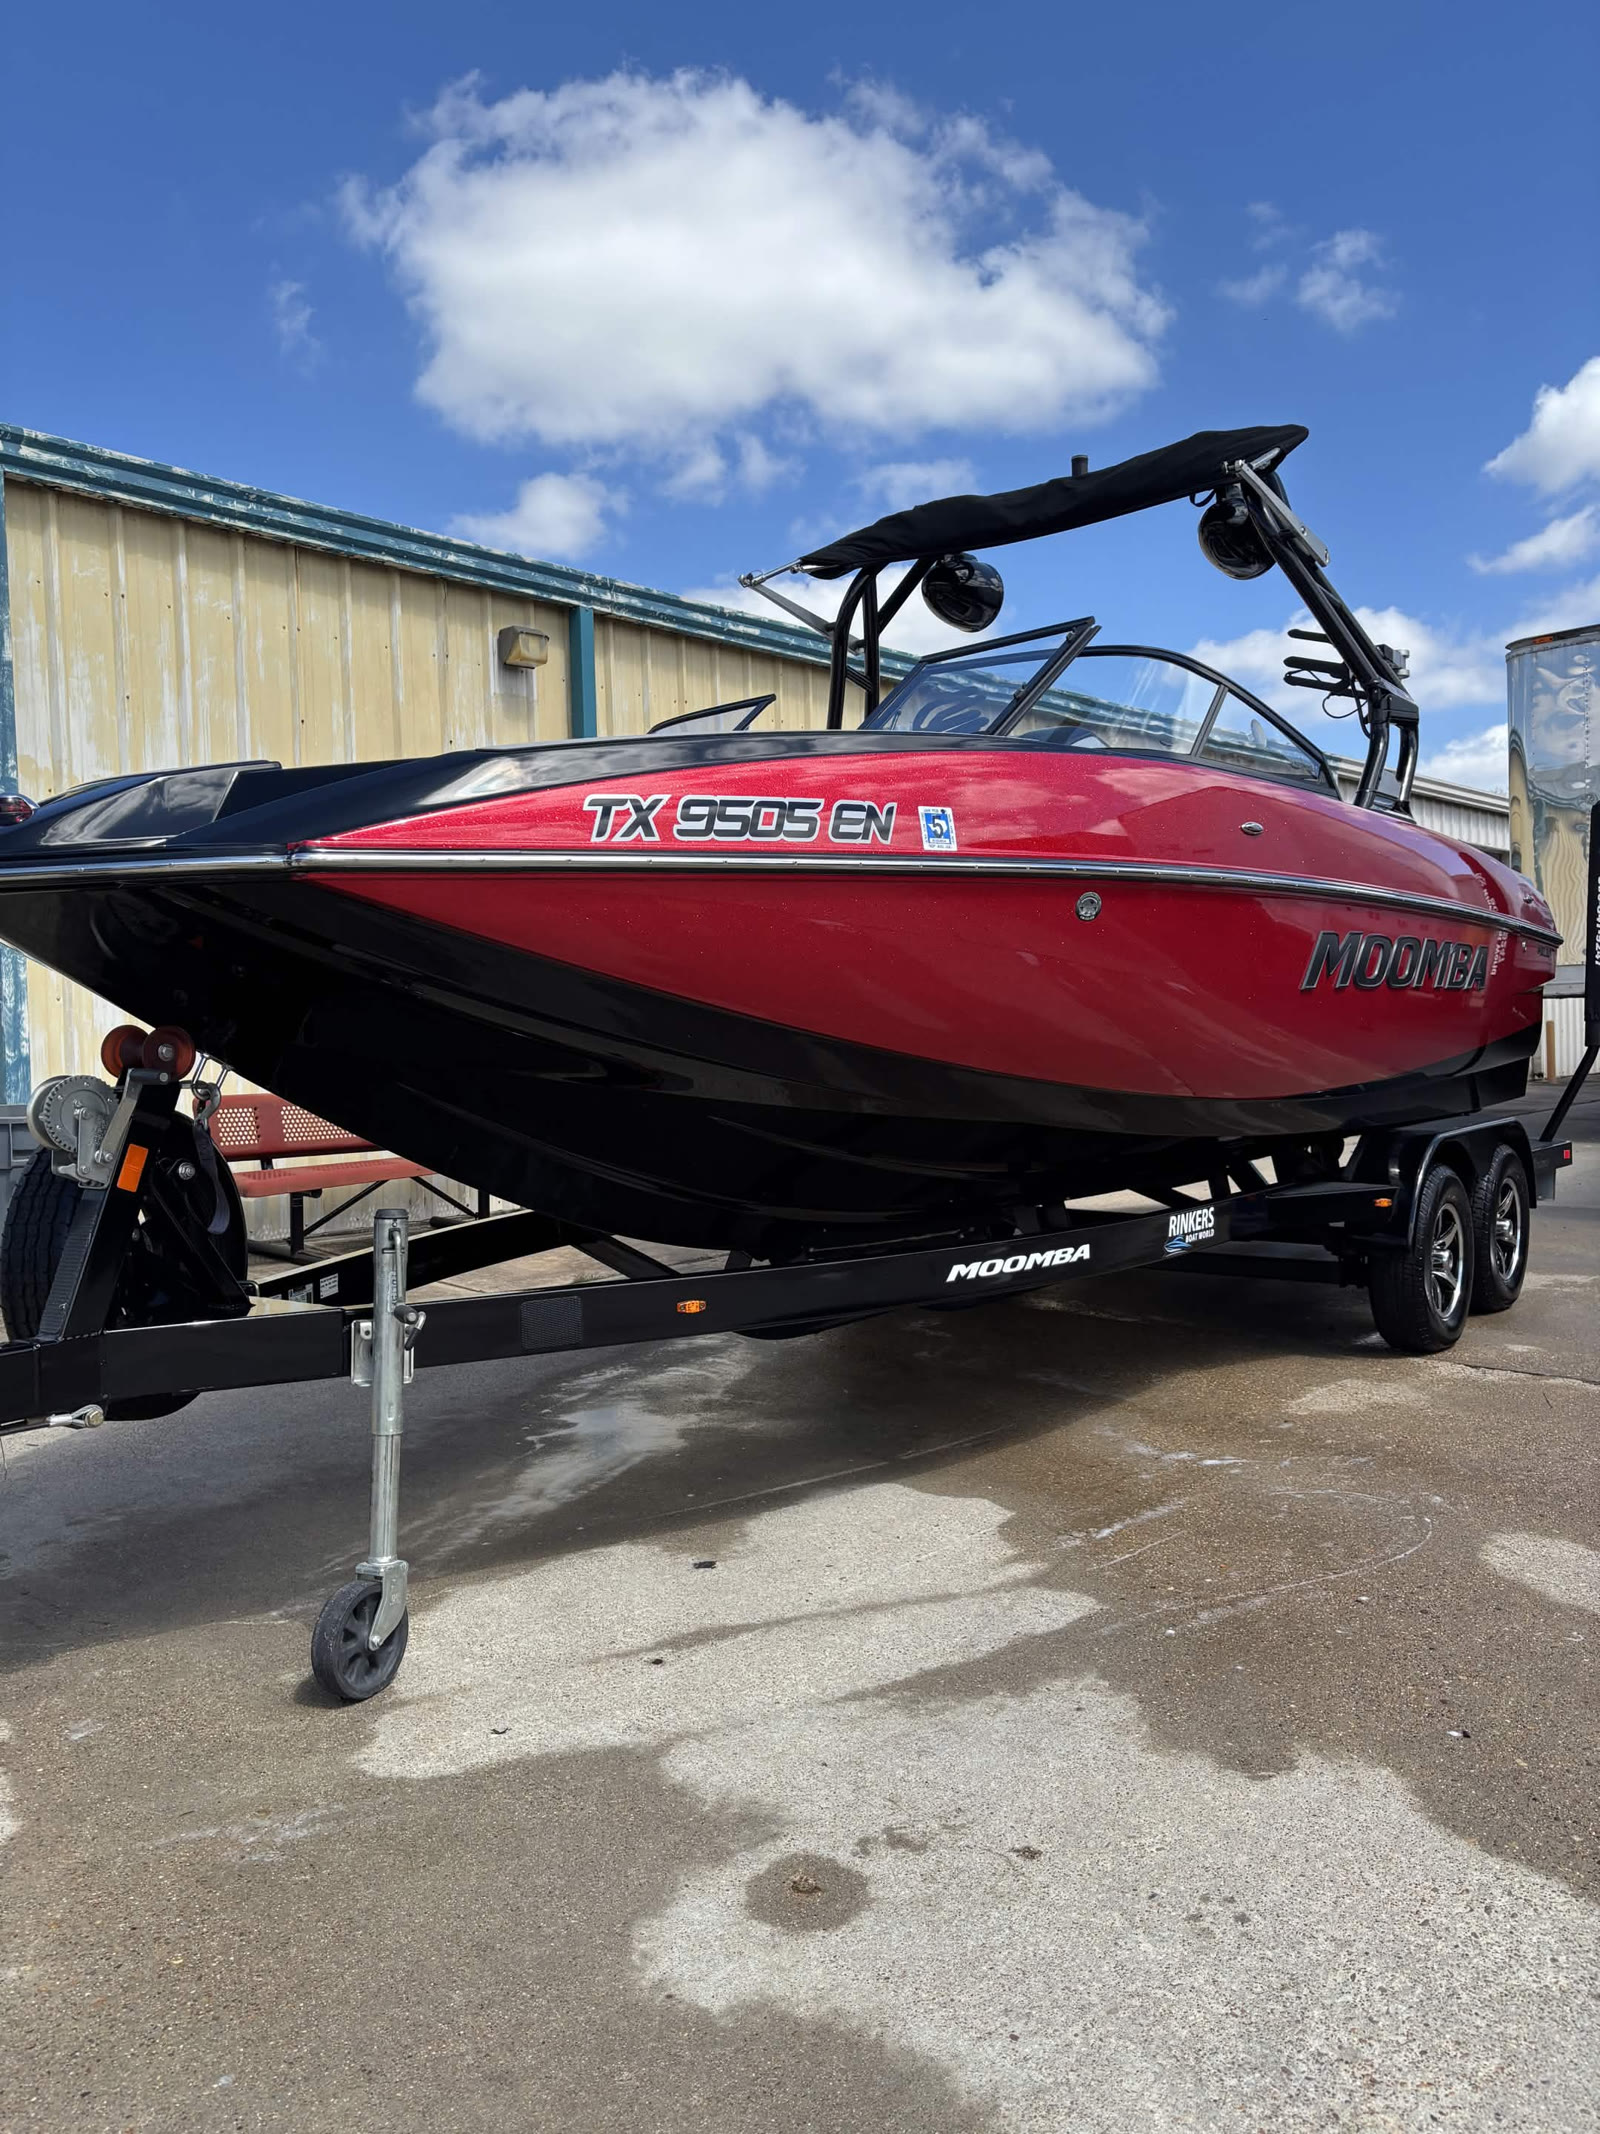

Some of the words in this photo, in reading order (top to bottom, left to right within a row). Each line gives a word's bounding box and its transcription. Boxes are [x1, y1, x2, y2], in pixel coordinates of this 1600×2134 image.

[583, 794, 671, 842] TX
[673, 795, 824, 842] 9505
[828, 800, 898, 844] EN
[931, 815, 944, 838] 5
[1300, 930, 1489, 991] MOOMBA
[1168, 1206, 1215, 1237] RINKERS
[1185, 1233, 1198, 1243] BOAT
[1198, 1228, 1215, 1240] WORLD
[945, 1243, 1091, 1283] MOOMBA
